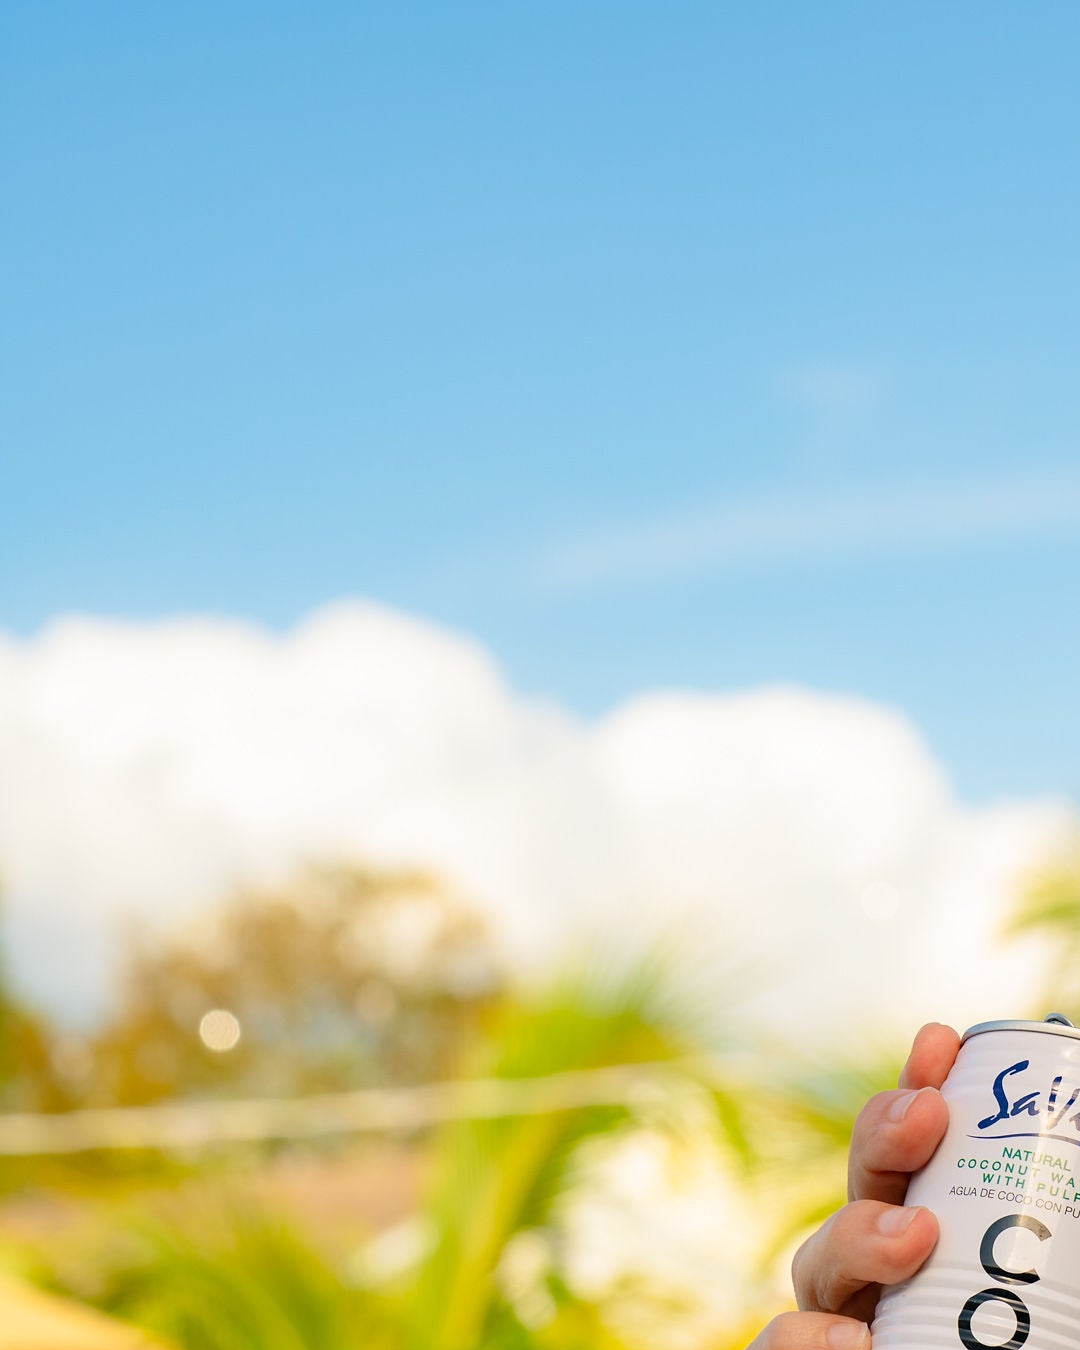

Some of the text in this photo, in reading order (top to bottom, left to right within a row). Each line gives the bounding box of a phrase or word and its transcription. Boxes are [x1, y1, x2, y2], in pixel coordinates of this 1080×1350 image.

[957, 1158, 1041, 1178] COCONUT
[1002, 1147, 1071, 1172] NATURAL
[982, 1173, 1026, 1189] WITH
[949, 1186, 977, 1197] AGUA
[980, 1187, 995, 1199] DE
[997, 1190, 1033, 1205] COCO
[1035, 1199, 1062, 1213] CON
